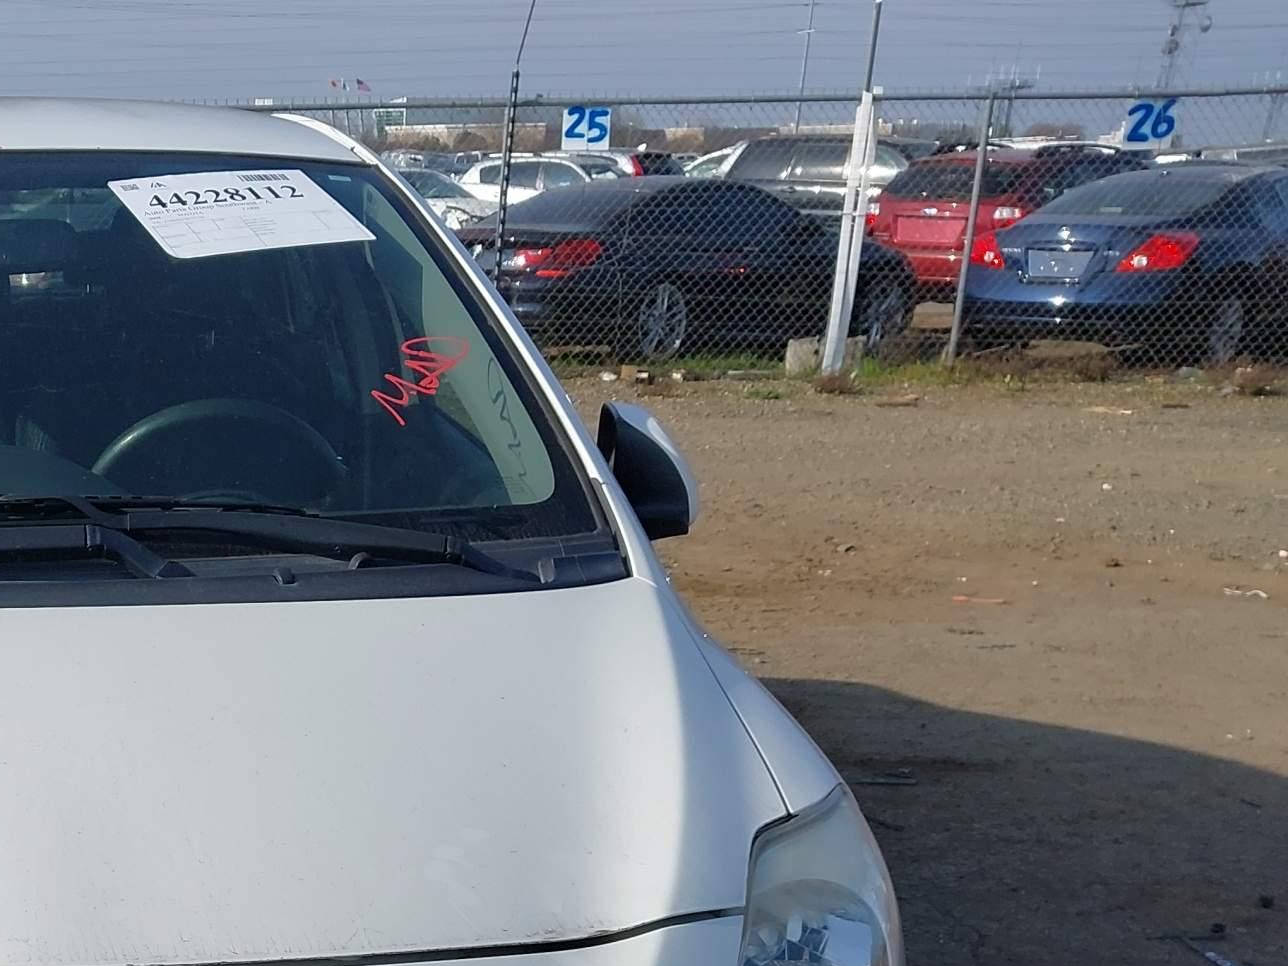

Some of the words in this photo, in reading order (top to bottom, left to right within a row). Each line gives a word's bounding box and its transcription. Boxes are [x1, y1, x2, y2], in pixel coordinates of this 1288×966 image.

[565, 105, 609, 143] 25
[1127, 97, 1176, 142] 26
[149, 185, 304, 208] 44228112
